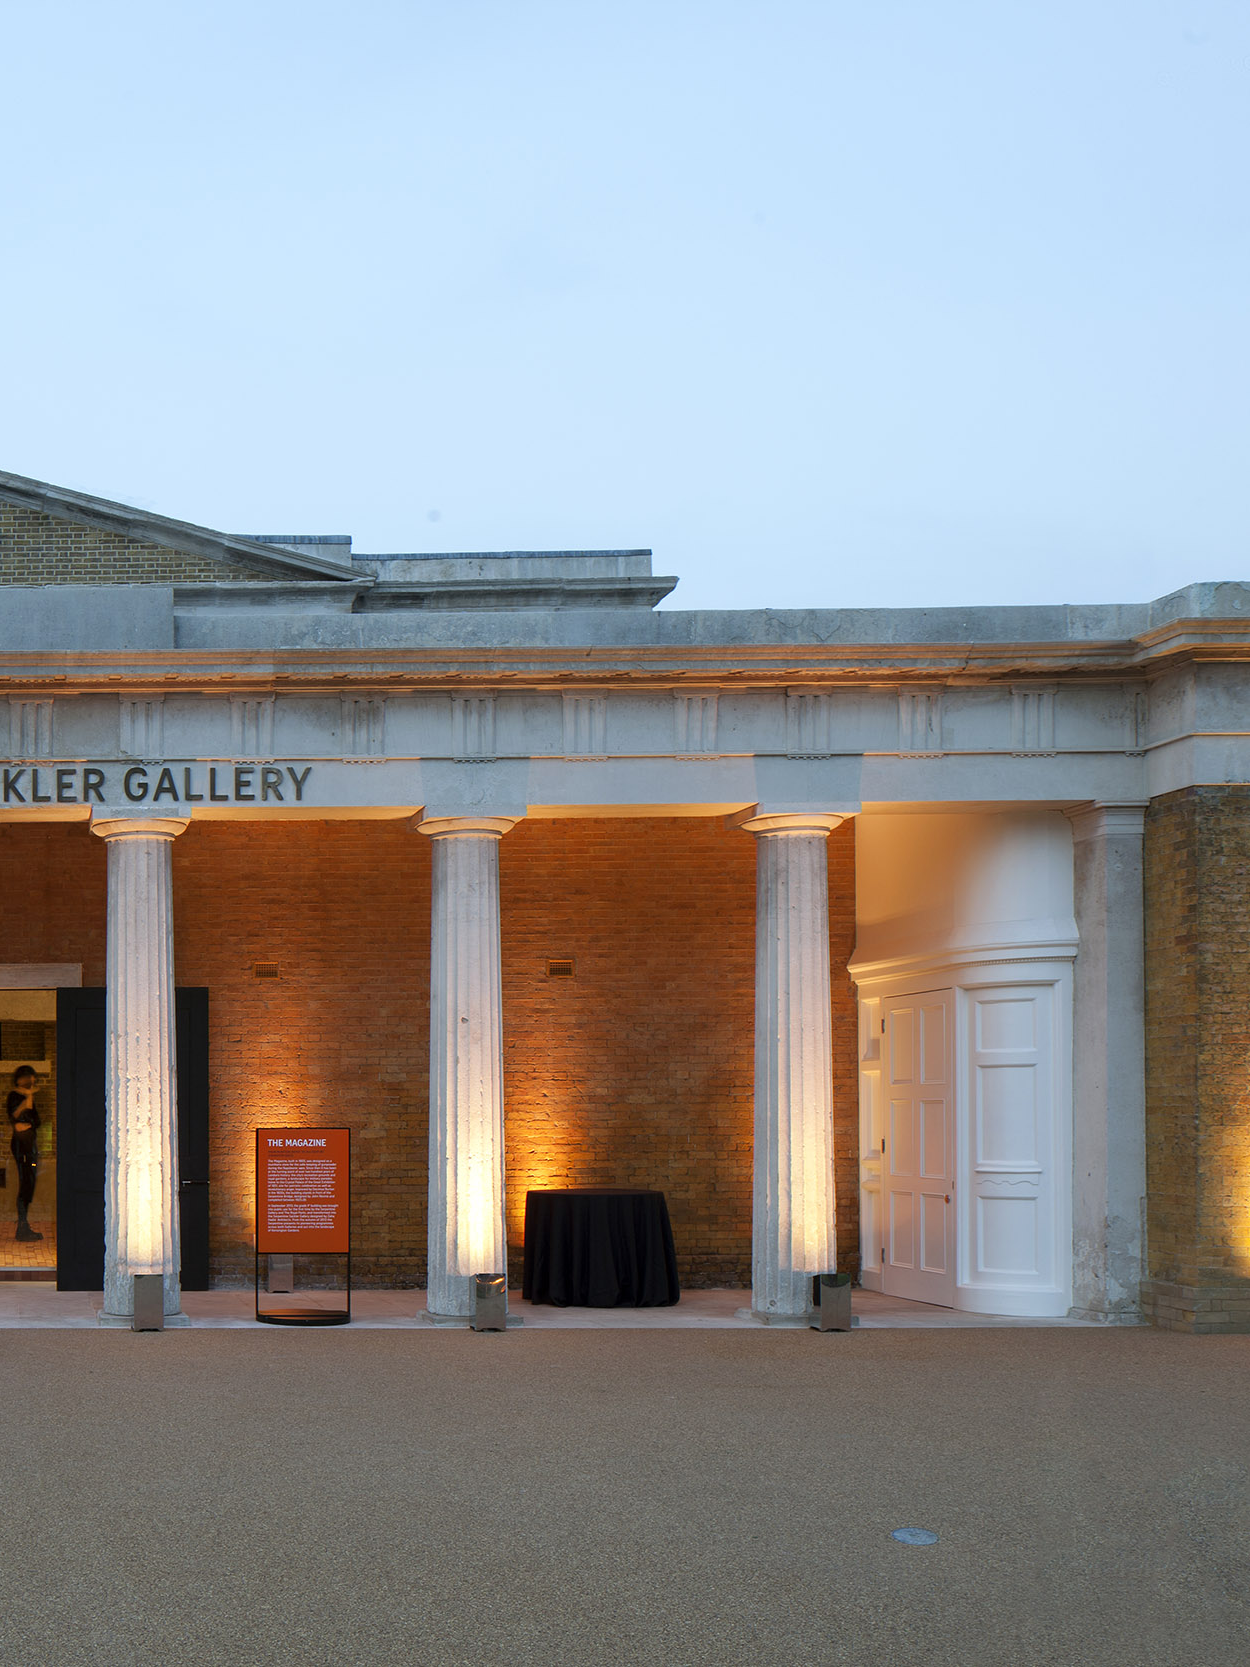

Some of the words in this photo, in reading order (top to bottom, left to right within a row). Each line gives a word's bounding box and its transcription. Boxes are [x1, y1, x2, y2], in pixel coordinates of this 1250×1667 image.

[123, 766, 313, 802] GALLERY
[267, 1138, 284, 1147] THE
[285, 1138, 327, 1147] MAGAZINE
